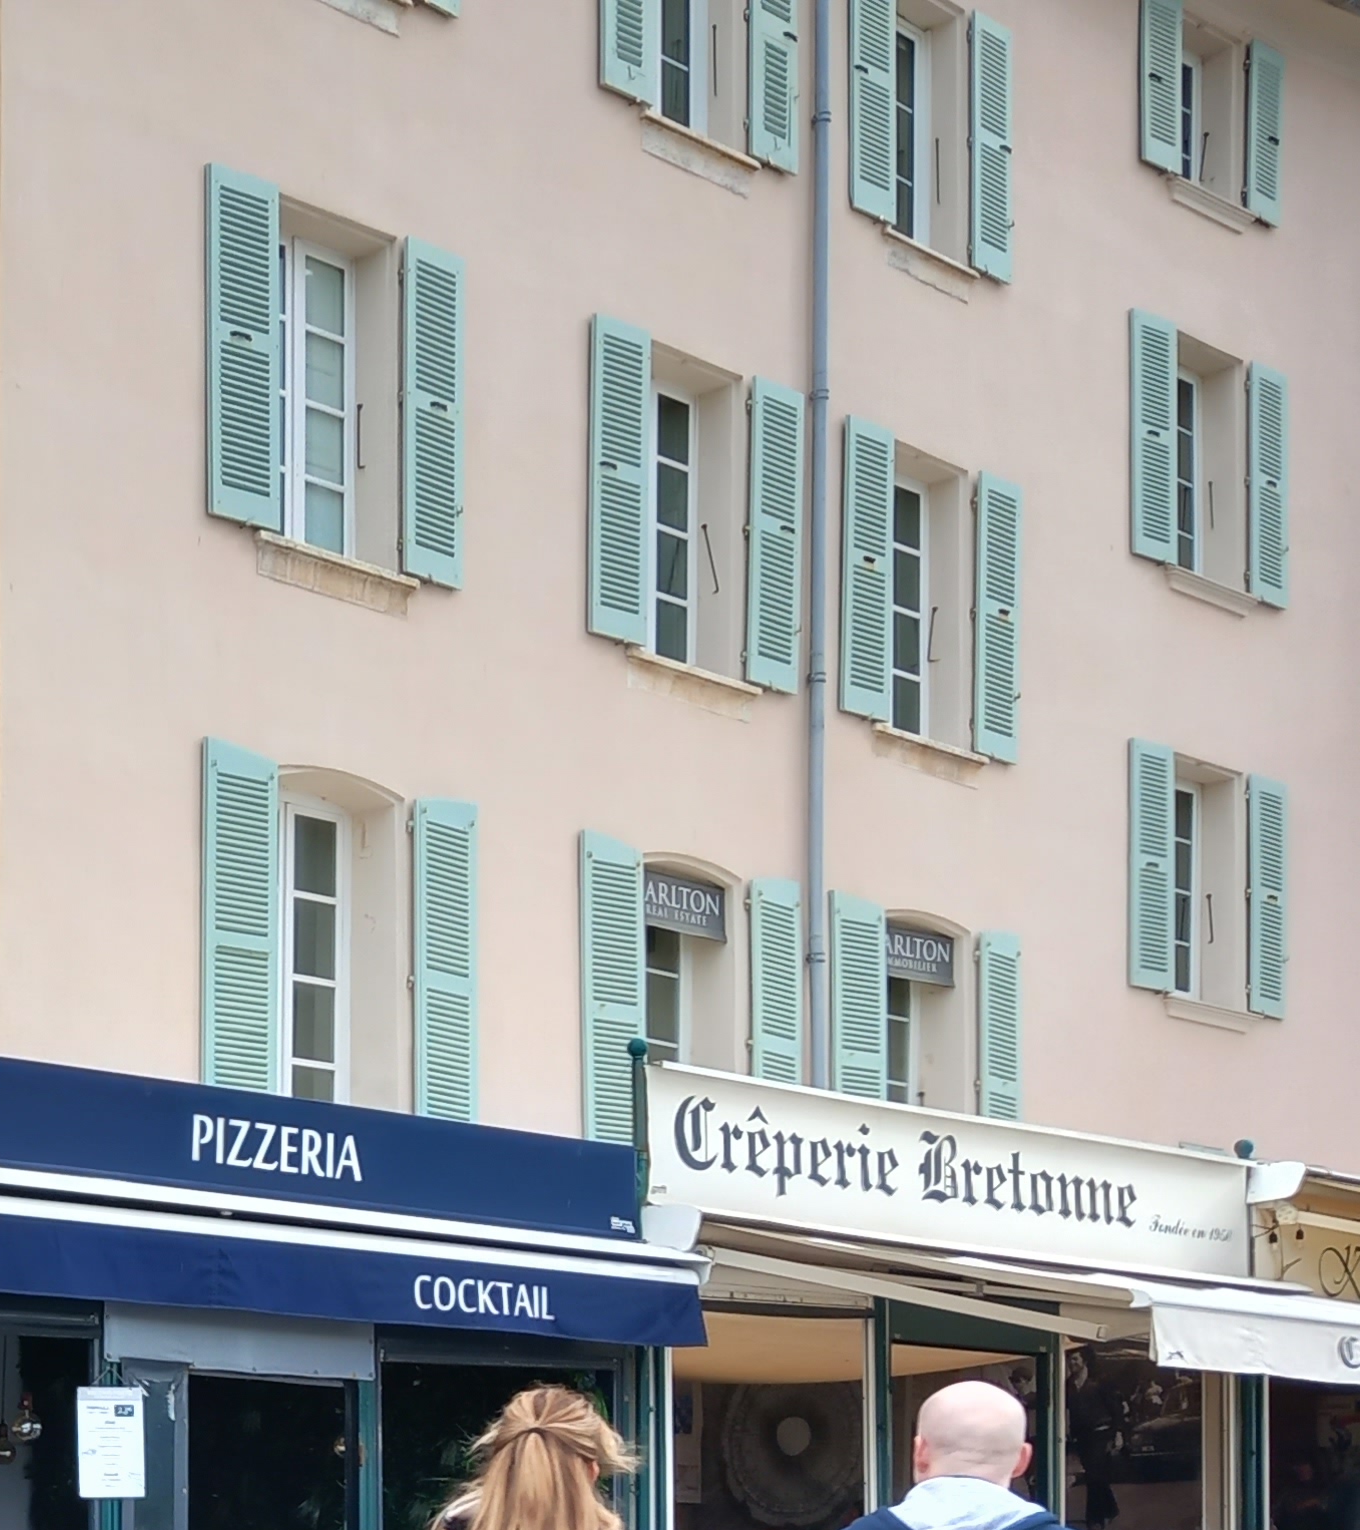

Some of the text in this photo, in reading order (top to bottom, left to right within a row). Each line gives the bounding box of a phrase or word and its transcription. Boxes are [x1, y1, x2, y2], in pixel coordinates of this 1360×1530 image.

[645, 880, 720, 916] ARLTON
[646, 904, 707, 926] REAL ESTATE
[192, 1114, 363, 1182] PIZZERIA
[674, 1095, 1138, 1229] Crêperie Bretonne
[1192, 1229, 1206, 1239] en
[414, 1274, 555, 1321] COCKTAIL
